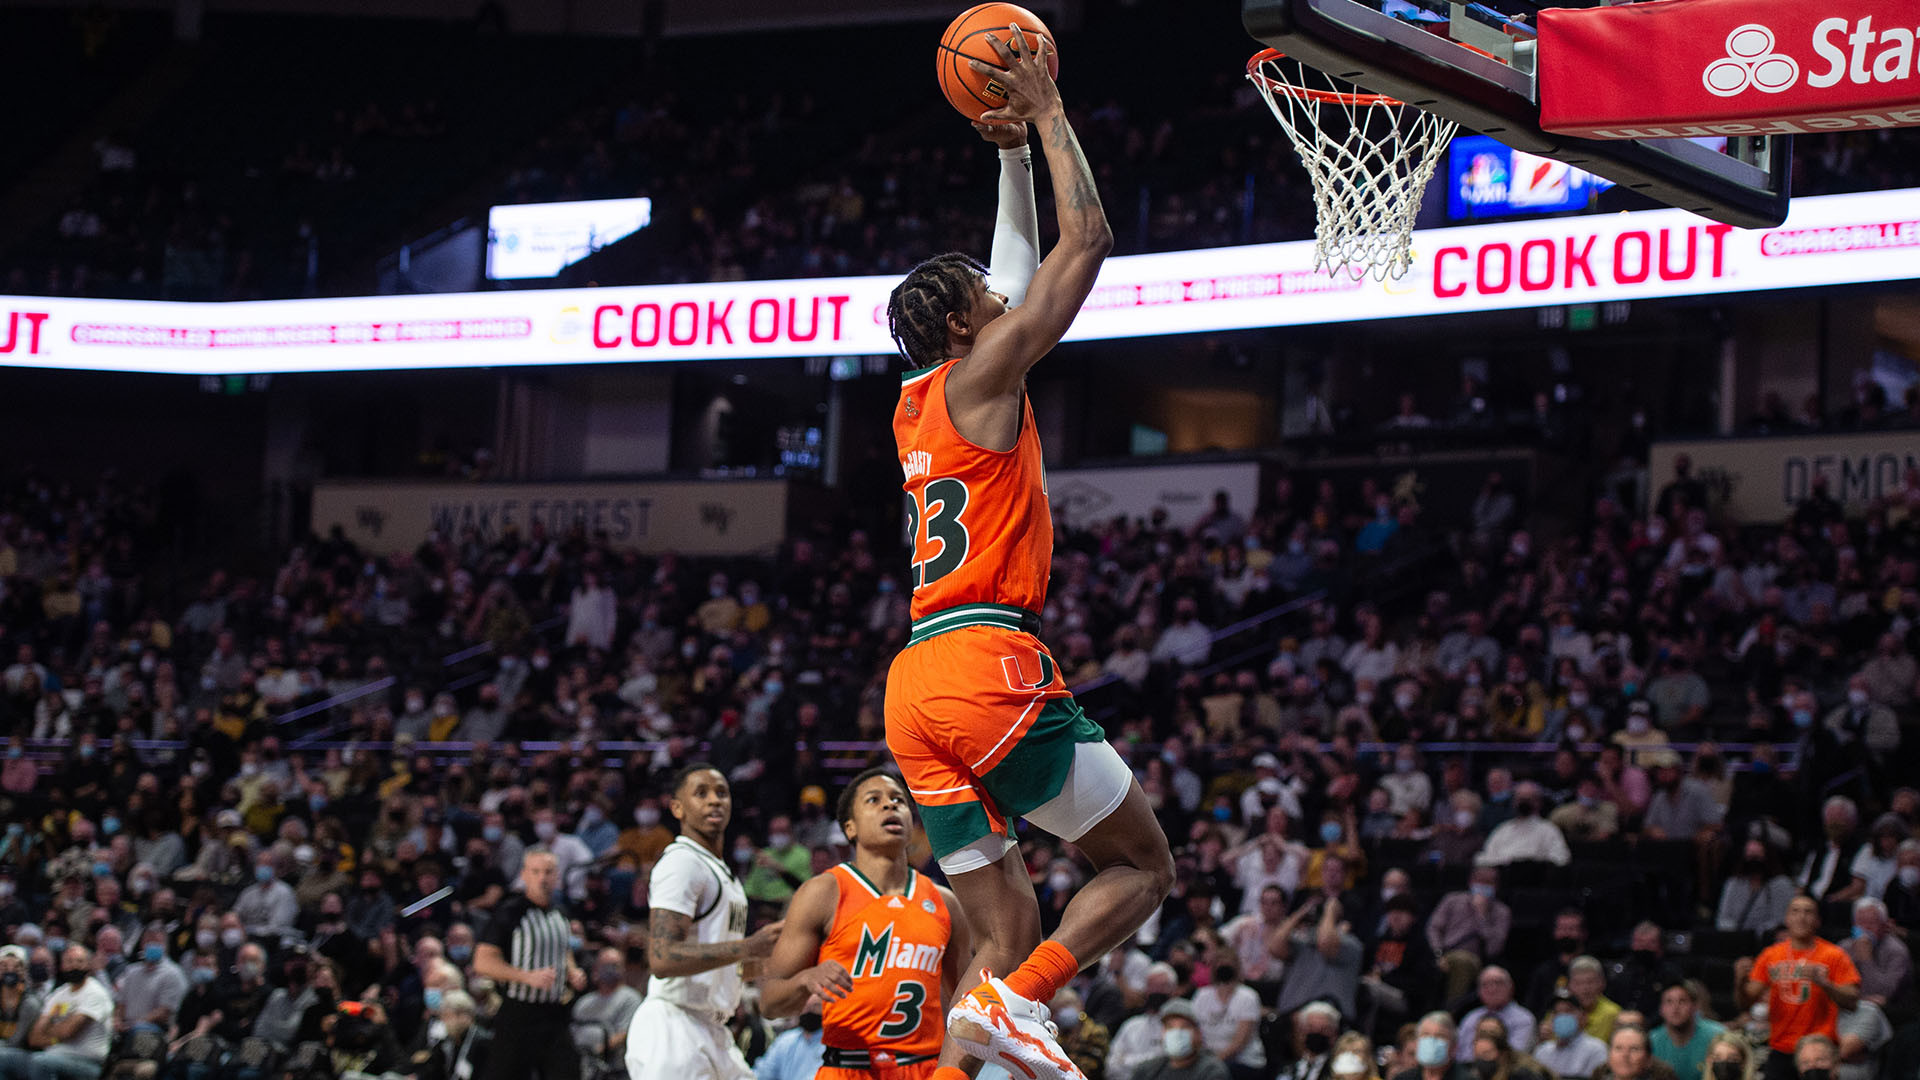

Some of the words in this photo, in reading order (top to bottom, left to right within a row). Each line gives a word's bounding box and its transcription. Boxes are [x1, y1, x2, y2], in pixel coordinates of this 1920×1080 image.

[1807, 14, 1920, 88] Sta
[1434, 236, 1597, 298] COOK
[1613, 223, 1735, 285] OUT
[593, 300, 734, 348] COOK
[749, 295, 849, 343] OUT
[1784, 452, 1920, 506] DEMO
[529, 498, 655, 541] FOREST
[1001, 650, 1054, 692] U
[852, 921, 946, 978] Miami
[876, 979, 926, 1038] 3
